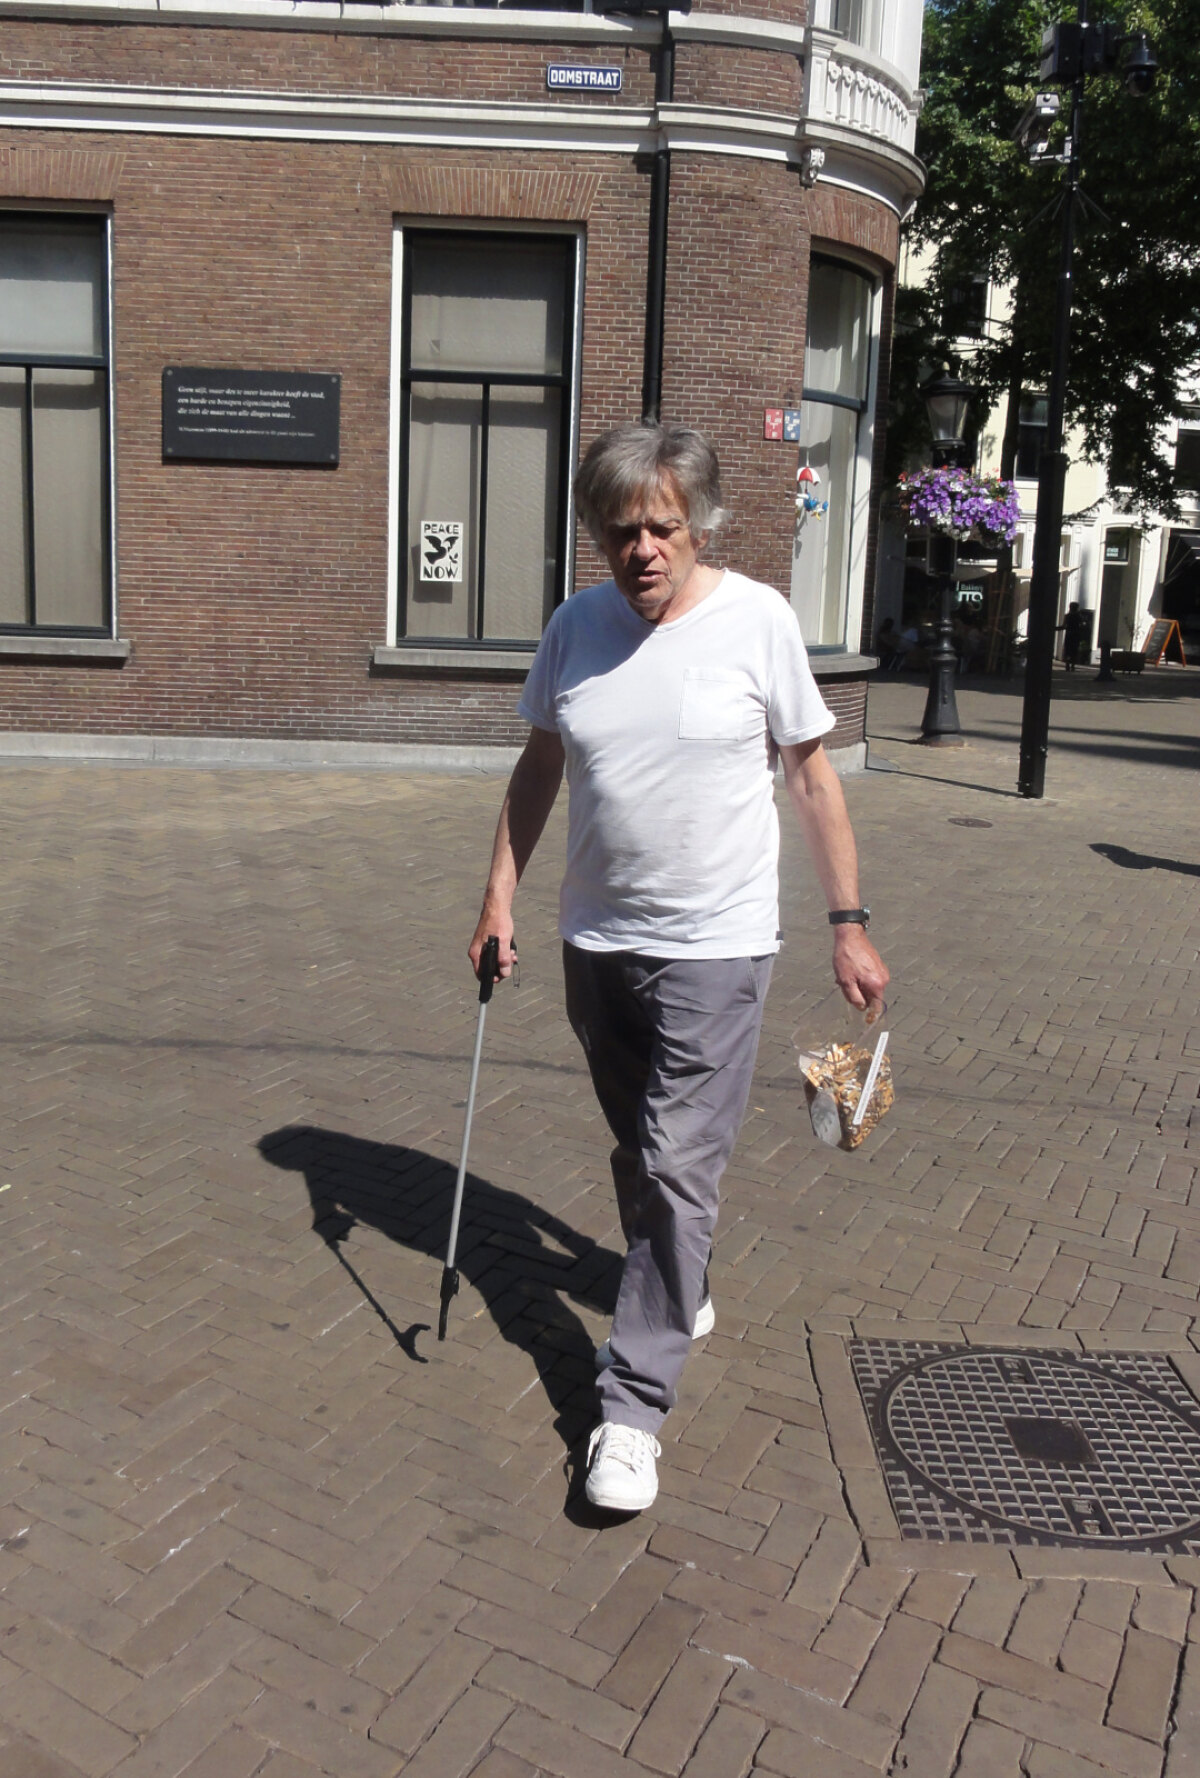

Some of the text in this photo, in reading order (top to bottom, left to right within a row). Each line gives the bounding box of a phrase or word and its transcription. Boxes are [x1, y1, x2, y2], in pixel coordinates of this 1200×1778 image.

[550, 69, 619, 86] DOMSTRAAT
[424, 523, 460, 535] PEACE
[423, 566, 459, 580] NOW
